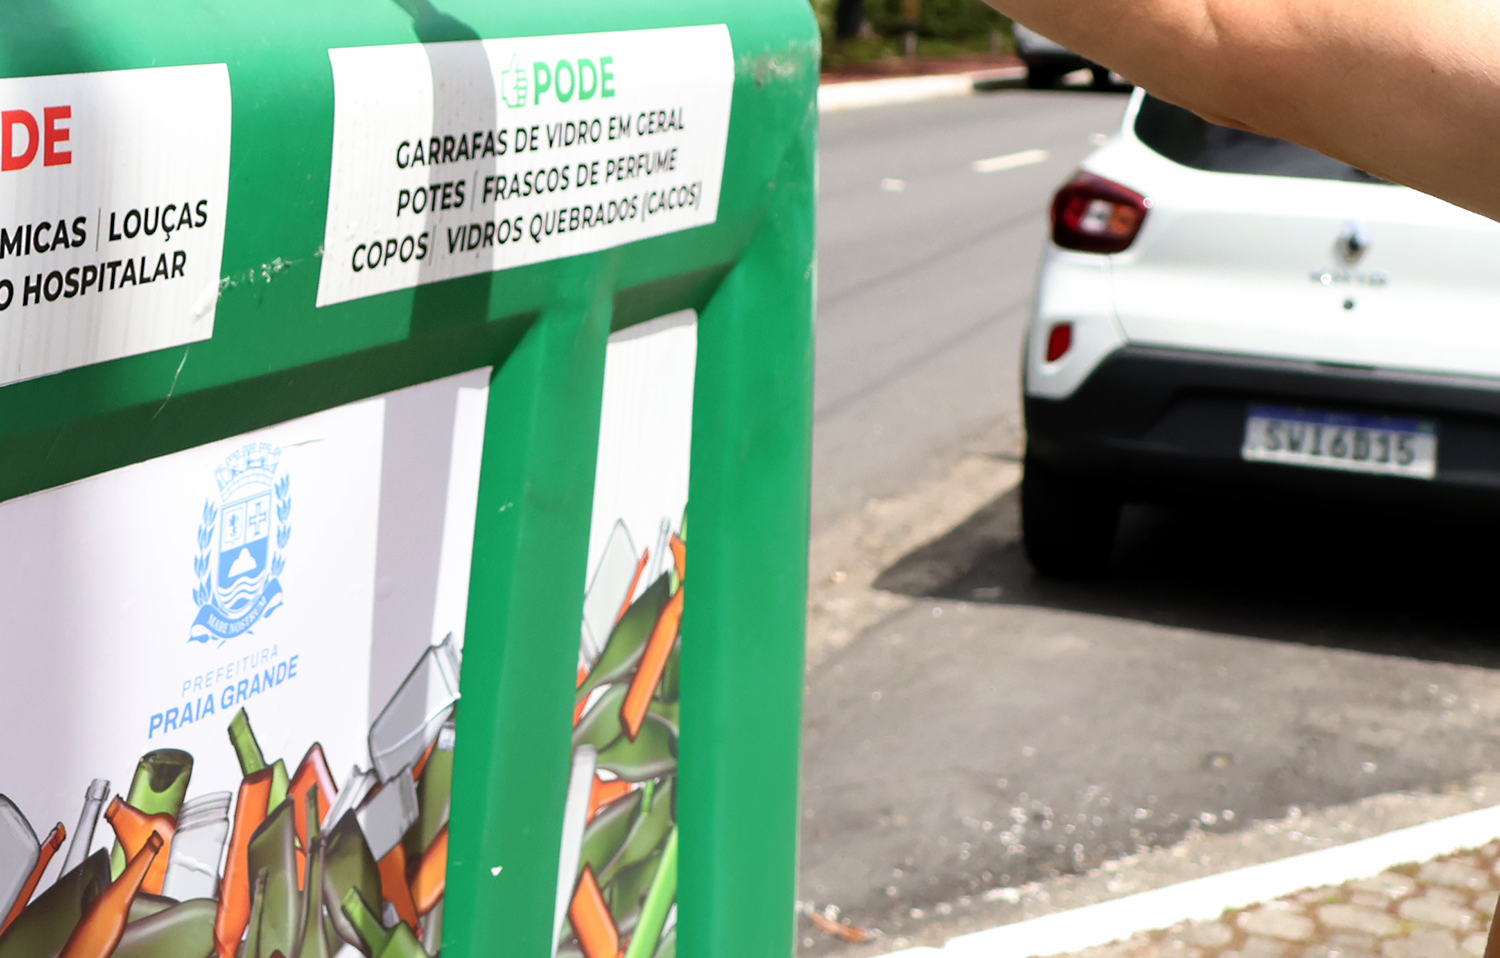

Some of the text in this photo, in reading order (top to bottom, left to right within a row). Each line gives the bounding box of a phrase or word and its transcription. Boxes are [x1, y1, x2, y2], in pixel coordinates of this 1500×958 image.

[533, 56, 616, 106] PODE
[397, 108, 684, 169] GARRAFAS DE VIDRO EM GERAL
[397, 148, 677, 217] POTES FRASCOS DE PERFUME
[109, 200, 207, 241] LOUÇAS
[352, 181, 702, 272] COPOS VIDROS QUEBRADOS (CACOS)
[23, 251, 186, 306] HOSPITALAR
[148, 654, 299, 739] PRAIA GRANDE
[182, 645, 277, 696] PREFEITURA
